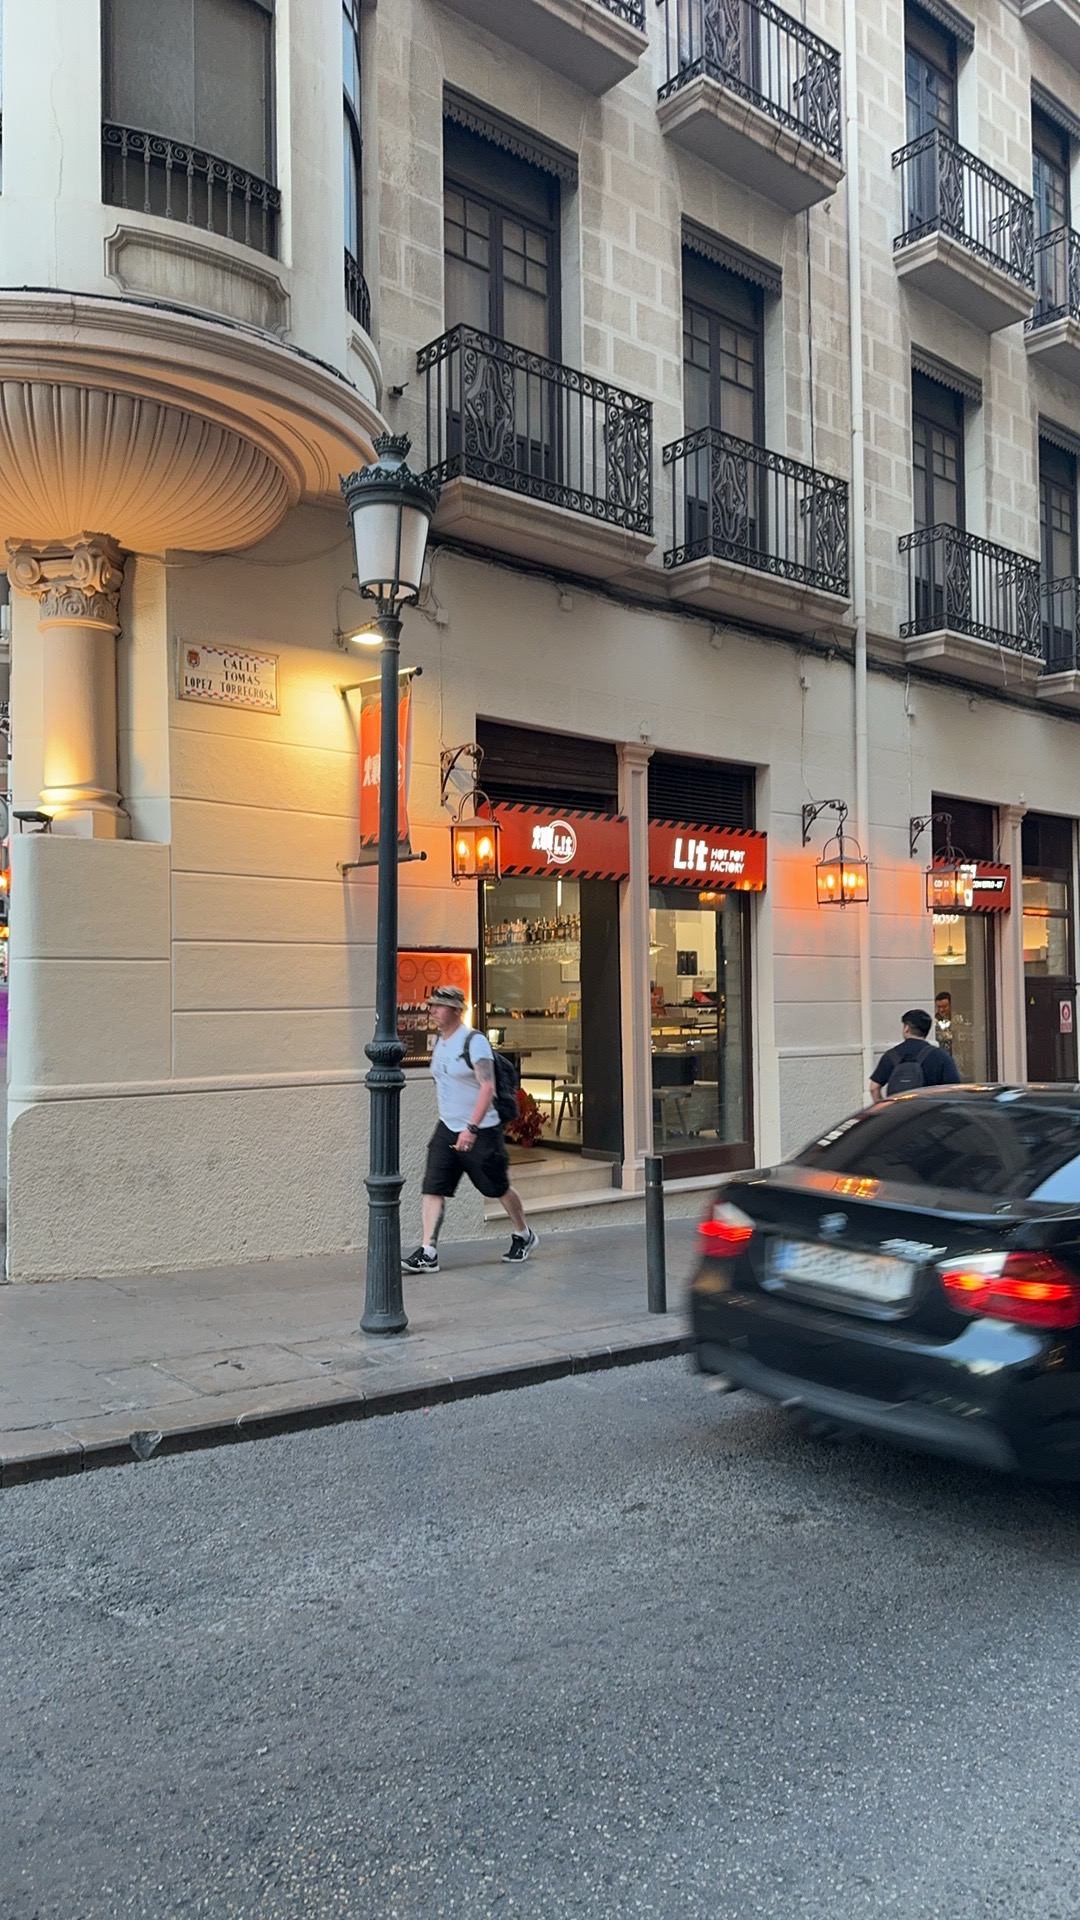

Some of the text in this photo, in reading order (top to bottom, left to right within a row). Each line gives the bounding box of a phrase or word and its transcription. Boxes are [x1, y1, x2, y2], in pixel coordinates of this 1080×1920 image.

[223, 658, 261, 674] CALLE
[223, 670, 261, 686] TOMAS
[185, 676, 274, 701] LOPEZ TORREGROSA
[711, 848, 746, 862] HOT POT
[710, 860, 745, 873] FACTORY
